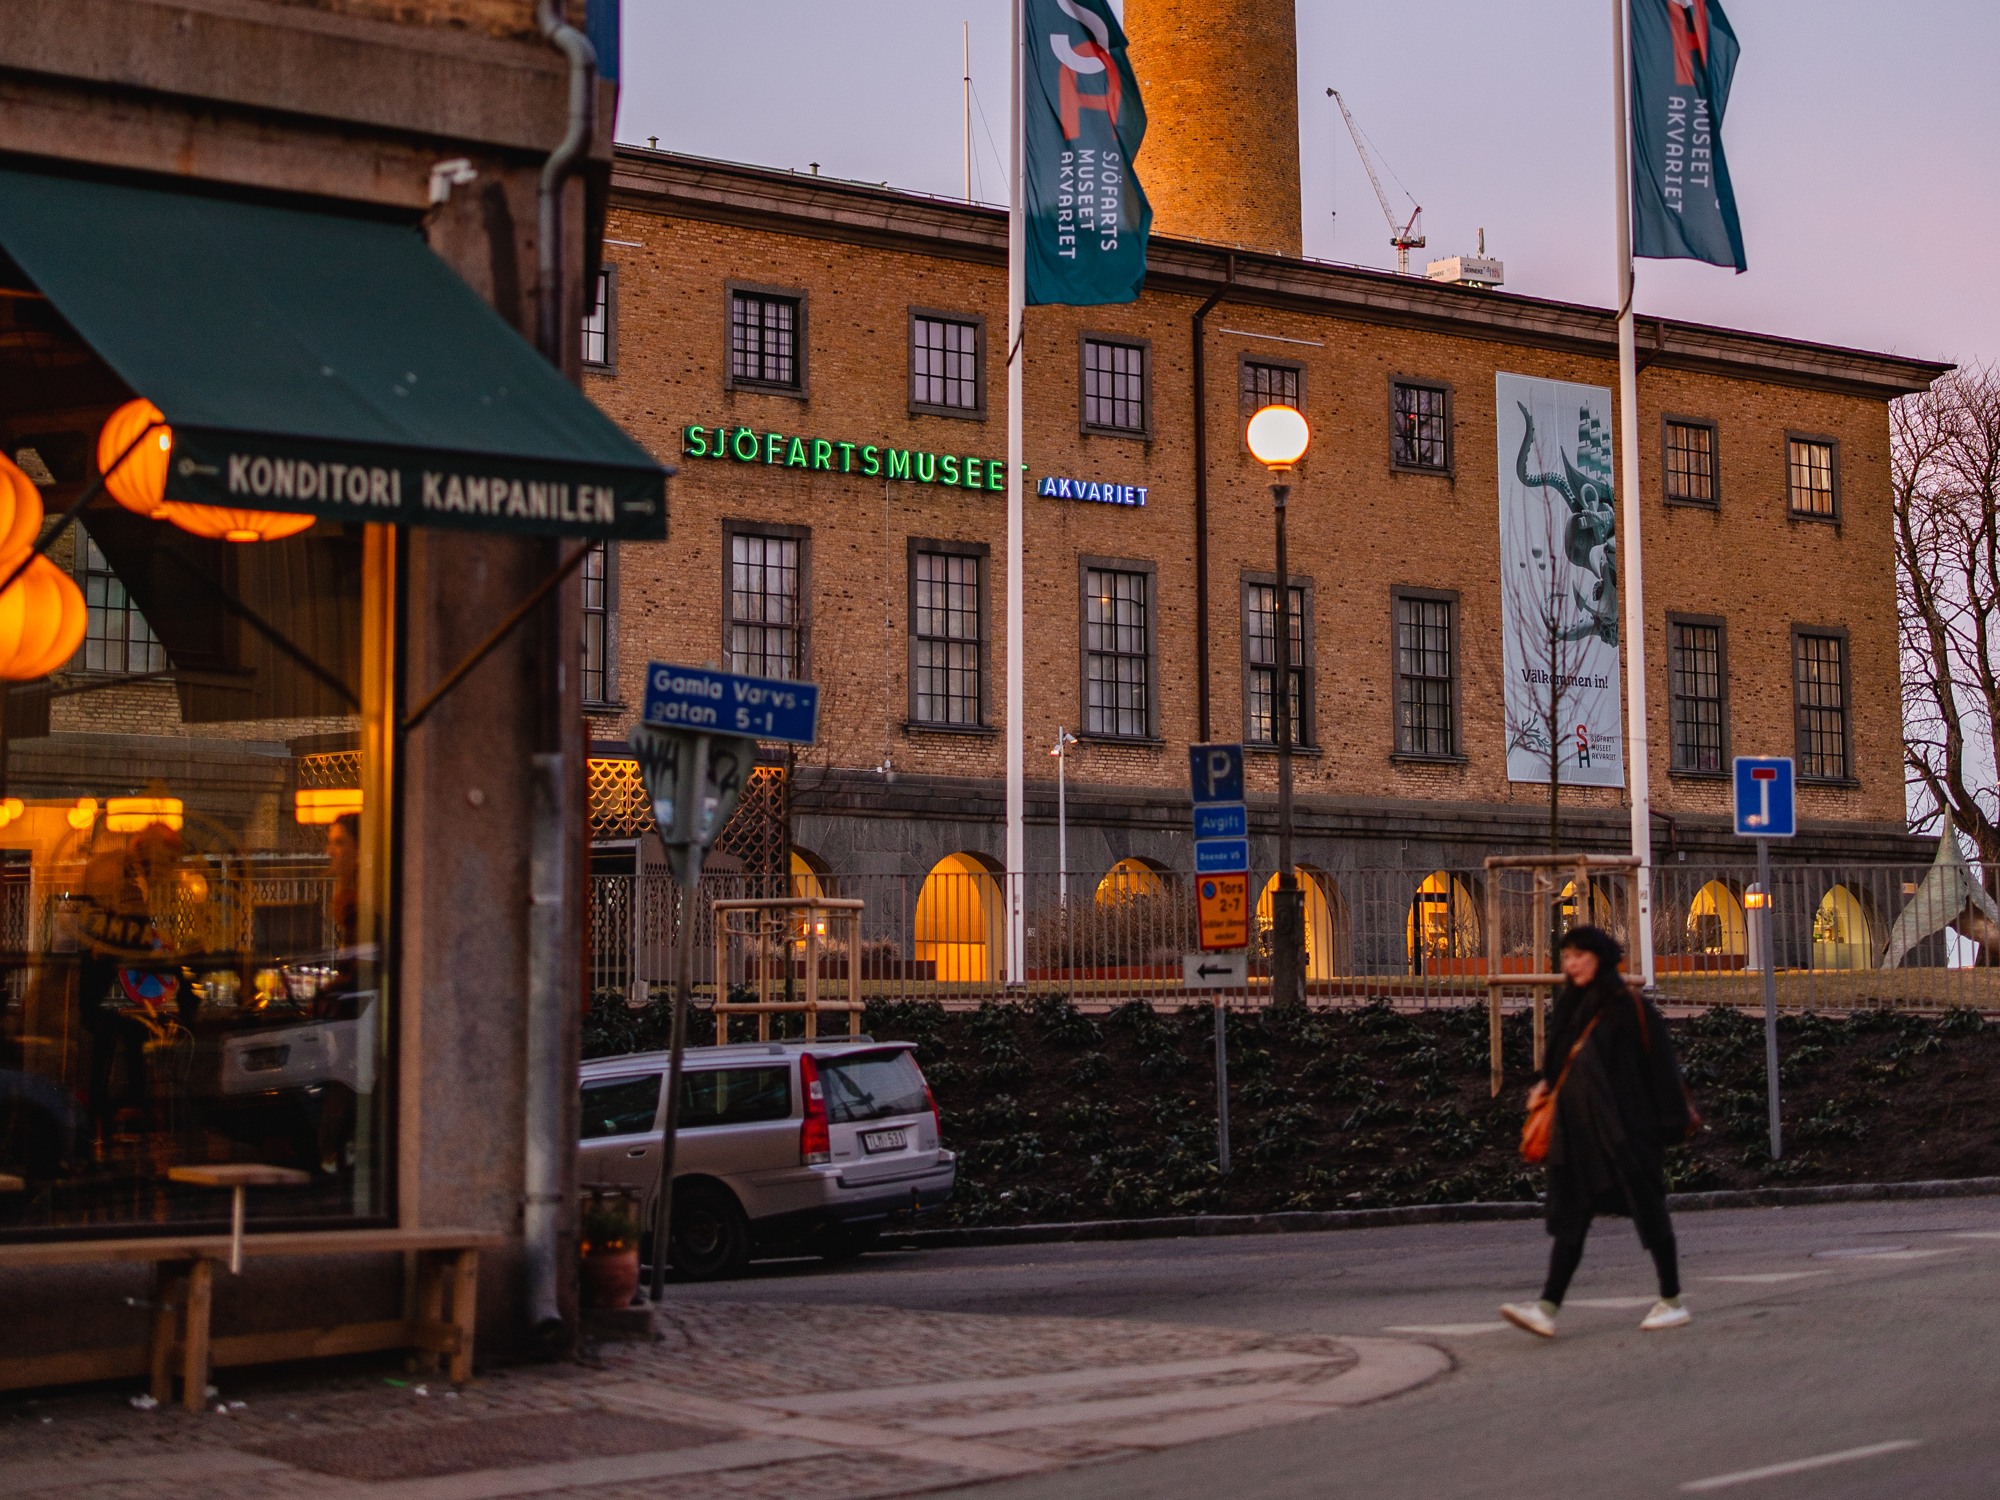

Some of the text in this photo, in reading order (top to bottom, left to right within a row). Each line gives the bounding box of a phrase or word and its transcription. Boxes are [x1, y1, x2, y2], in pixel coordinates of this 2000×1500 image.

[1665, 96, 1687, 213] AKVARIET
[1690, 98, 1710, 188] MUSEET
[1058, 151, 1075, 259] AKVARIET
[1078, 149, 1095, 232] MUSEET
[1100, 151, 1122, 251] SJÖFARTS
[685, 425, 1028, 491] SJÖFARTSMUSEE
[228, 454, 615, 524] KONDITORI KAMPANILEN
[1044, 477, 1148, 507] AKVARIET
[654, 669, 723, 700] Gamla
[1594, 674, 1608, 689] in!
[651, 701, 717, 725] gatan
[1591, 744, 1611, 752] MUSEET
[1591, 753, 1616, 761] AKVARIET
[1202, 815, 1239, 831] Avgift
[1219, 881, 1244, 895] Tors
[1220, 898, 1240, 913] 2-7
